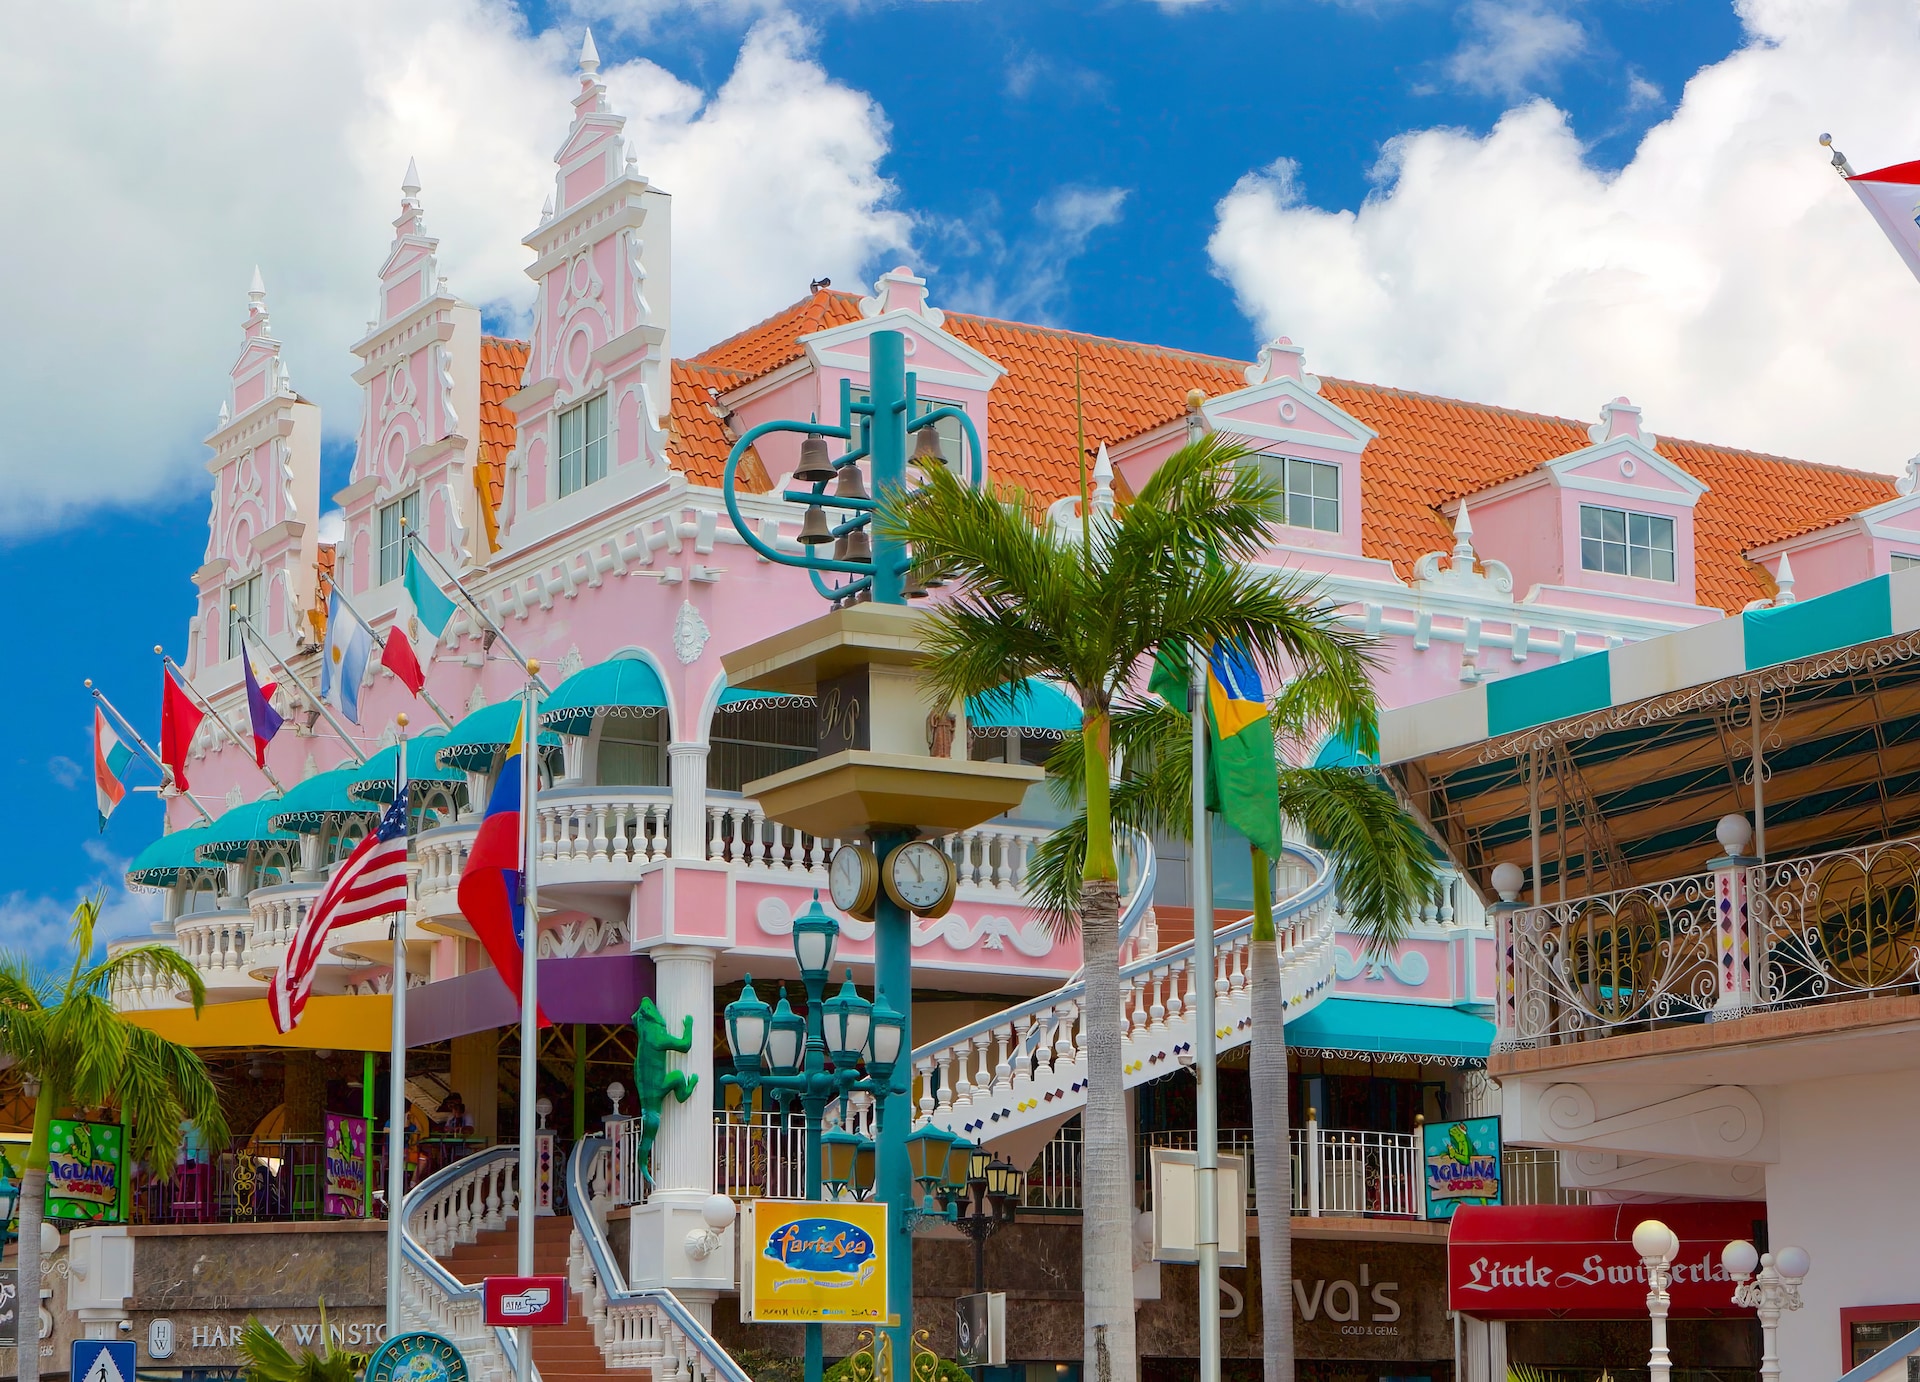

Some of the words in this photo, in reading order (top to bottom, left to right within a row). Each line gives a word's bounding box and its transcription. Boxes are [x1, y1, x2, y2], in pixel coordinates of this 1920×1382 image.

[50, 1160, 115, 1187] IGUANA
[1429, 1160, 1495, 1183] IGUANA
[1458, 1256, 1553, 1292] Little
[505, 1301, 521, 1311] ATM
[192, 1324, 283, 1347] HARY
[1341, 1325, 1365, 1335] GOLD
[1374, 1326, 1398, 1336] GEMS
